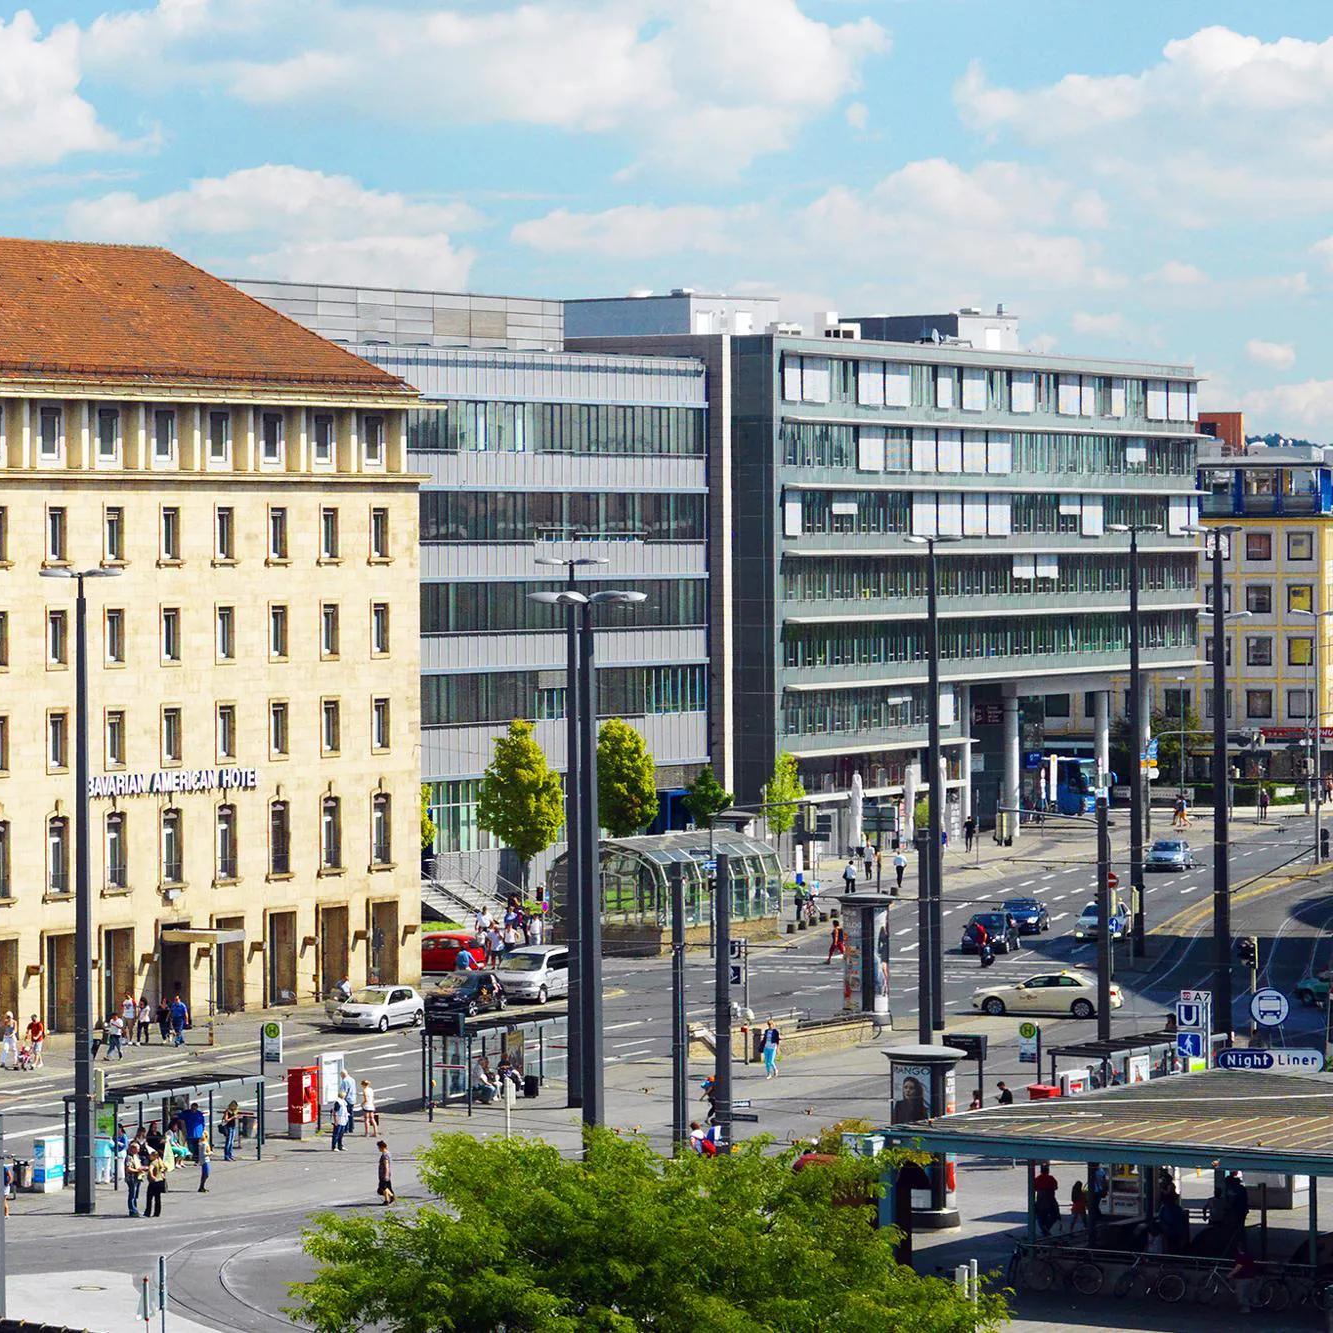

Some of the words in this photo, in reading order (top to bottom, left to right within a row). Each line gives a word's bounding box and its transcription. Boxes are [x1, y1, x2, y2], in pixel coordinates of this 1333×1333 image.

[152, 769, 215, 793] AMERICAN
[1180, 1005, 1197, 1025] U
[1227, 1054, 1269, 1068] Night
[1278, 1054, 1318, 1066] Liner
